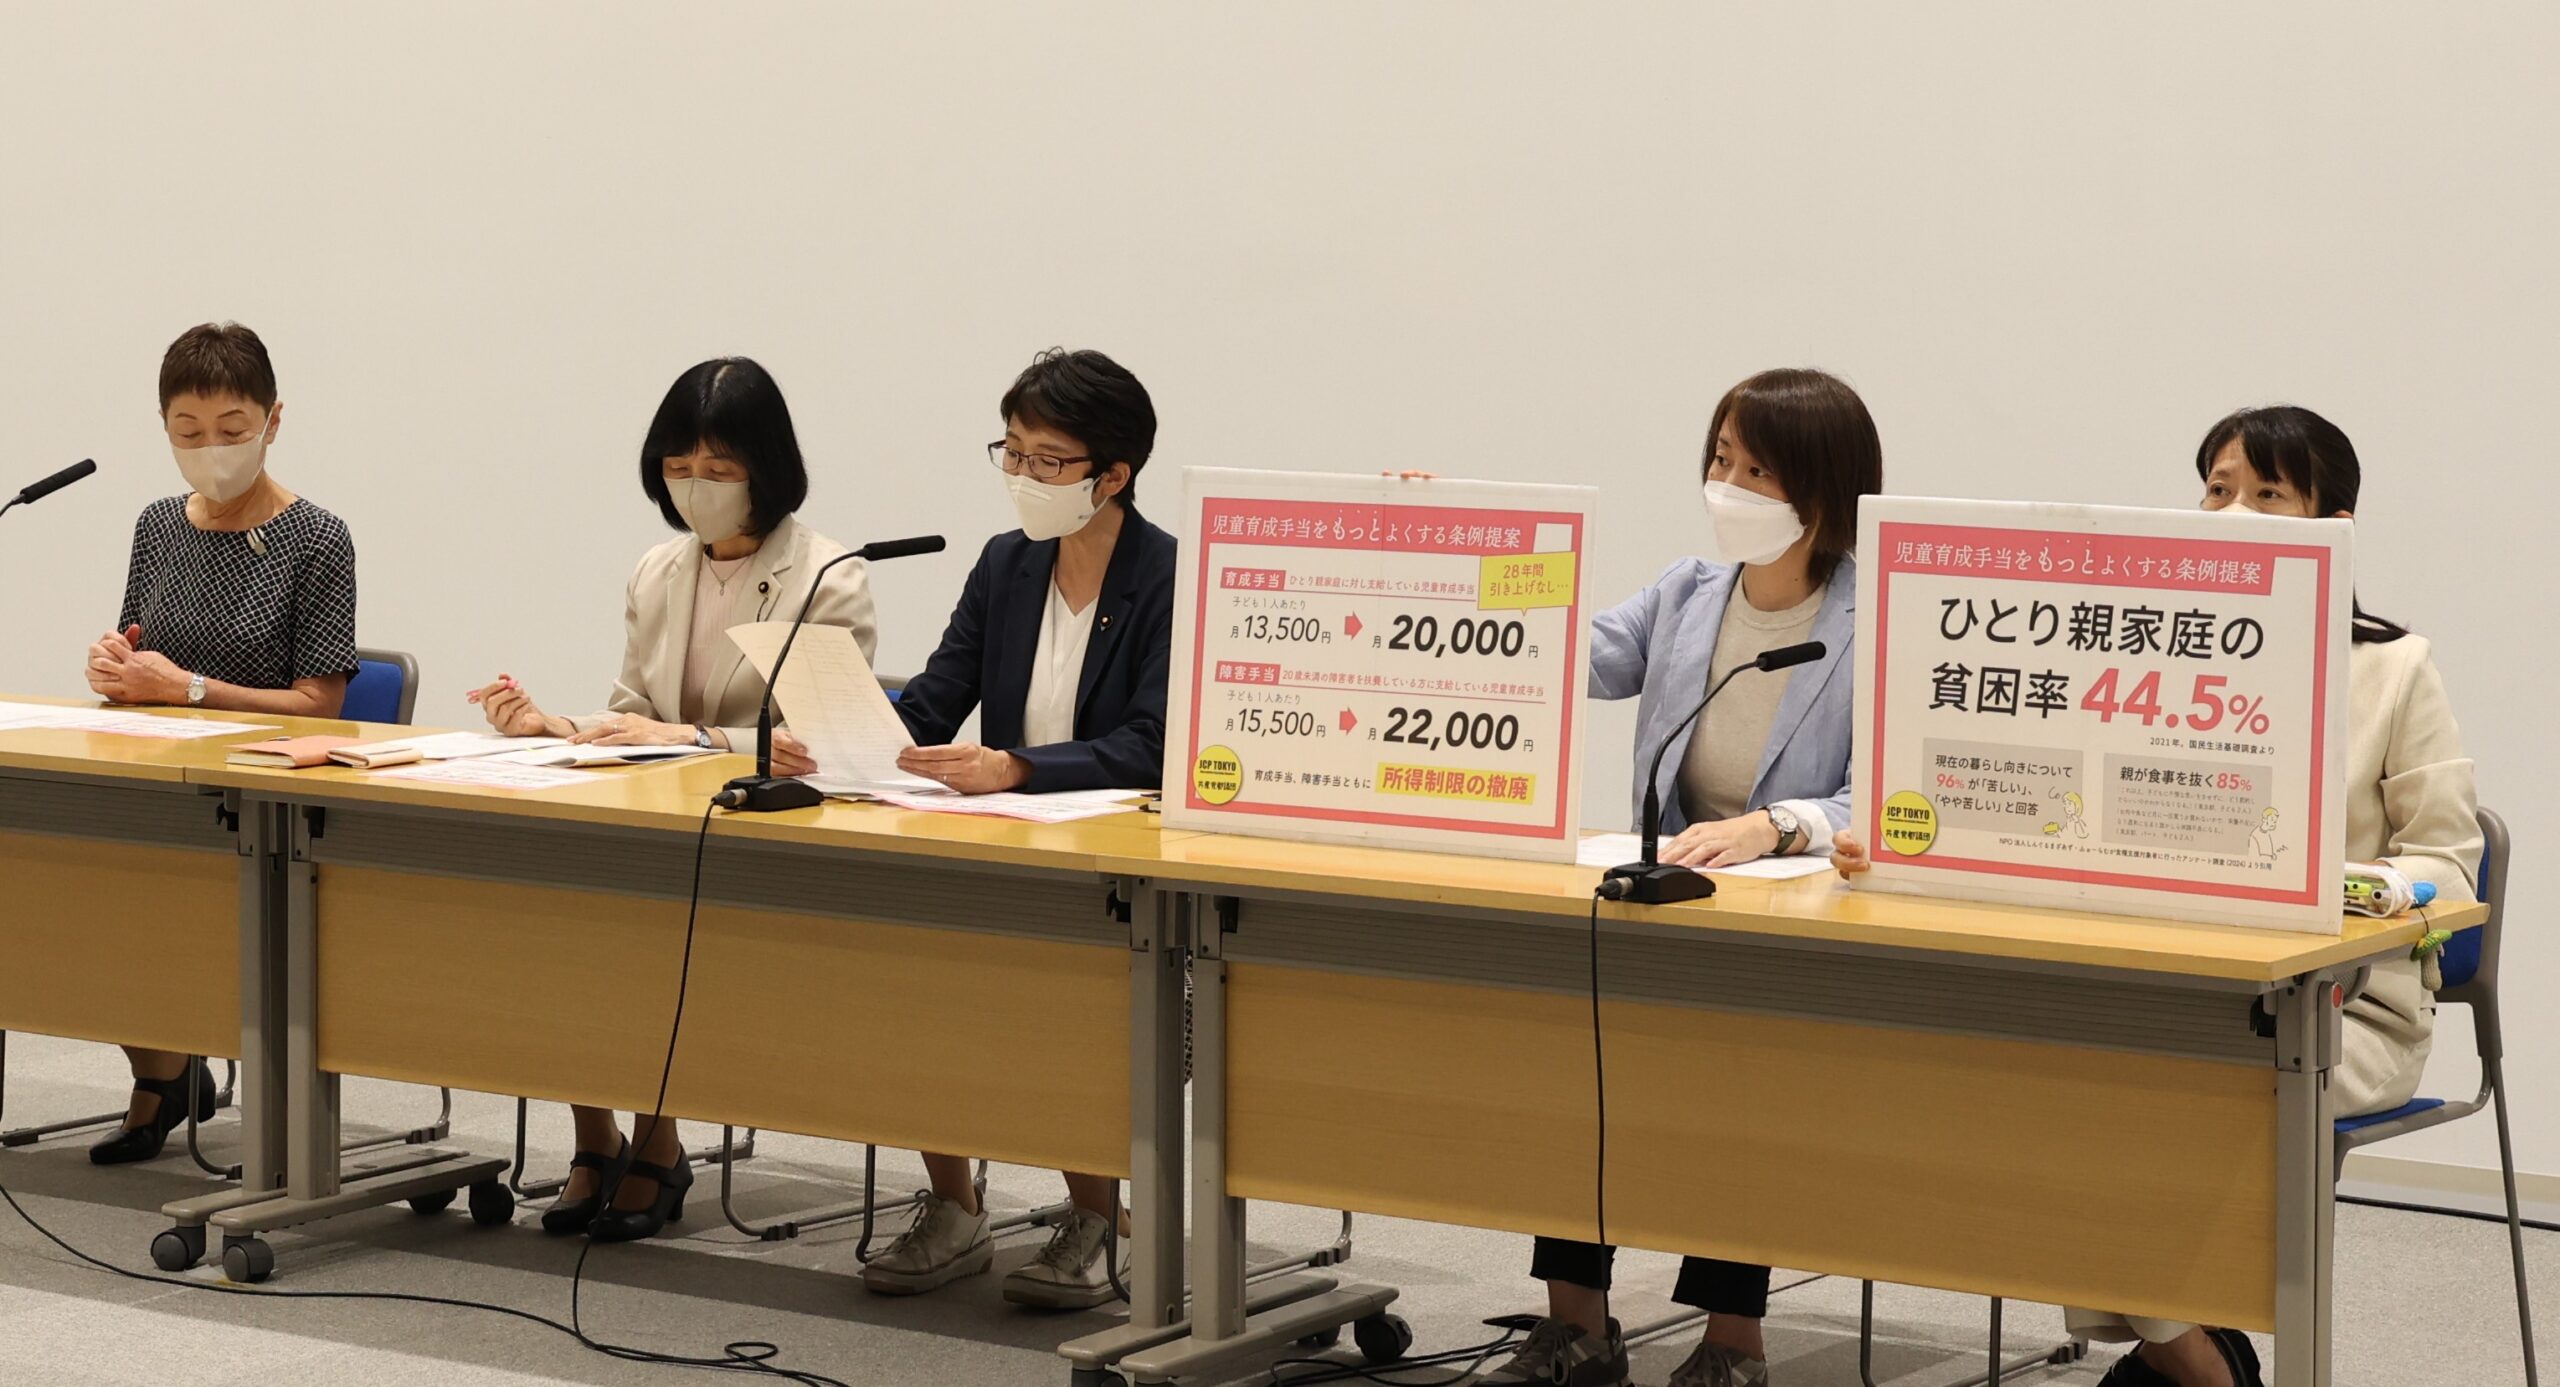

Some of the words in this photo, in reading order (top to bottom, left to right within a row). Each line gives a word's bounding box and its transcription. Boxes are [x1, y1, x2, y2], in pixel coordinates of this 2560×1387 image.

[1211, 511, 1521, 548] 児童育成手当をもっとよくする条例提案
[1503, 563, 1544, 580] 28年間
[1894, 539, 2261, 585] 児童育成手当をもっとよくする条例提案
[1225, 571, 1280, 588] 育成手当
[1940, 598, 2264, 660] ひとり親家庭の
[1219, 664, 1276, 682] 障害手当
[1198, 759, 1212, 769] JCP
[1213, 760, 1236, 771] TOKYO
[1935, 754, 2073, 778] 現在の暮らし向きについて
[1382, 767, 1529, 800] 所得制限の撤廃
[1886, 805, 1902, 817] JCP
[1903, 807, 1930, 820] TOKYO
